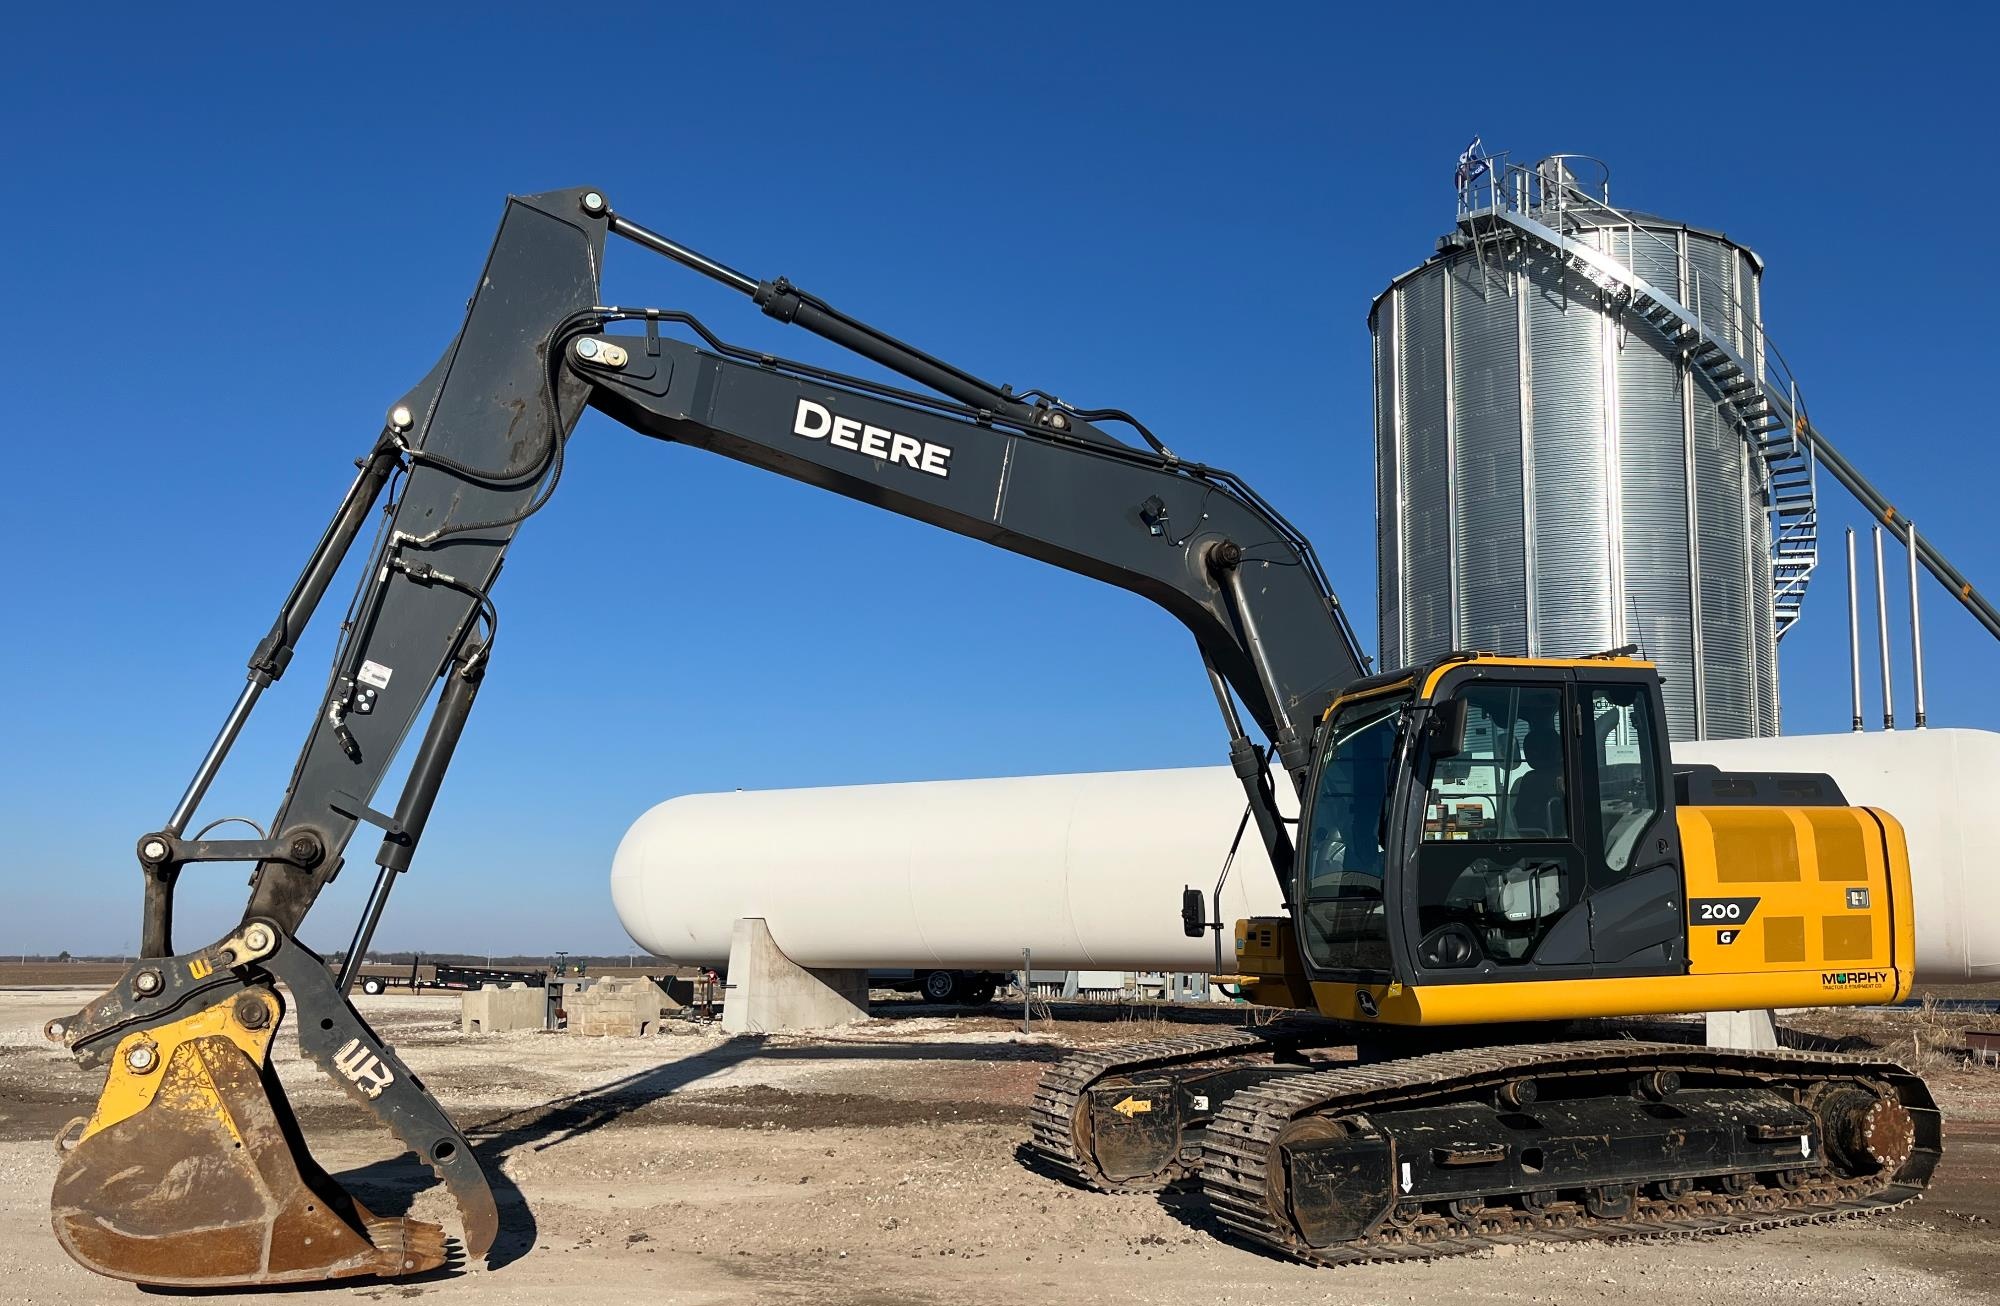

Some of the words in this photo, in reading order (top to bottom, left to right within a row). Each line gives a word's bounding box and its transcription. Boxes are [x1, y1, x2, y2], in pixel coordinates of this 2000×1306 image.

[793, 398, 952, 477] DEERE
[1701, 904, 1740, 919] 200
[1720, 931, 1731, 943] G
[1822, 972, 1887, 984] MURPHY
